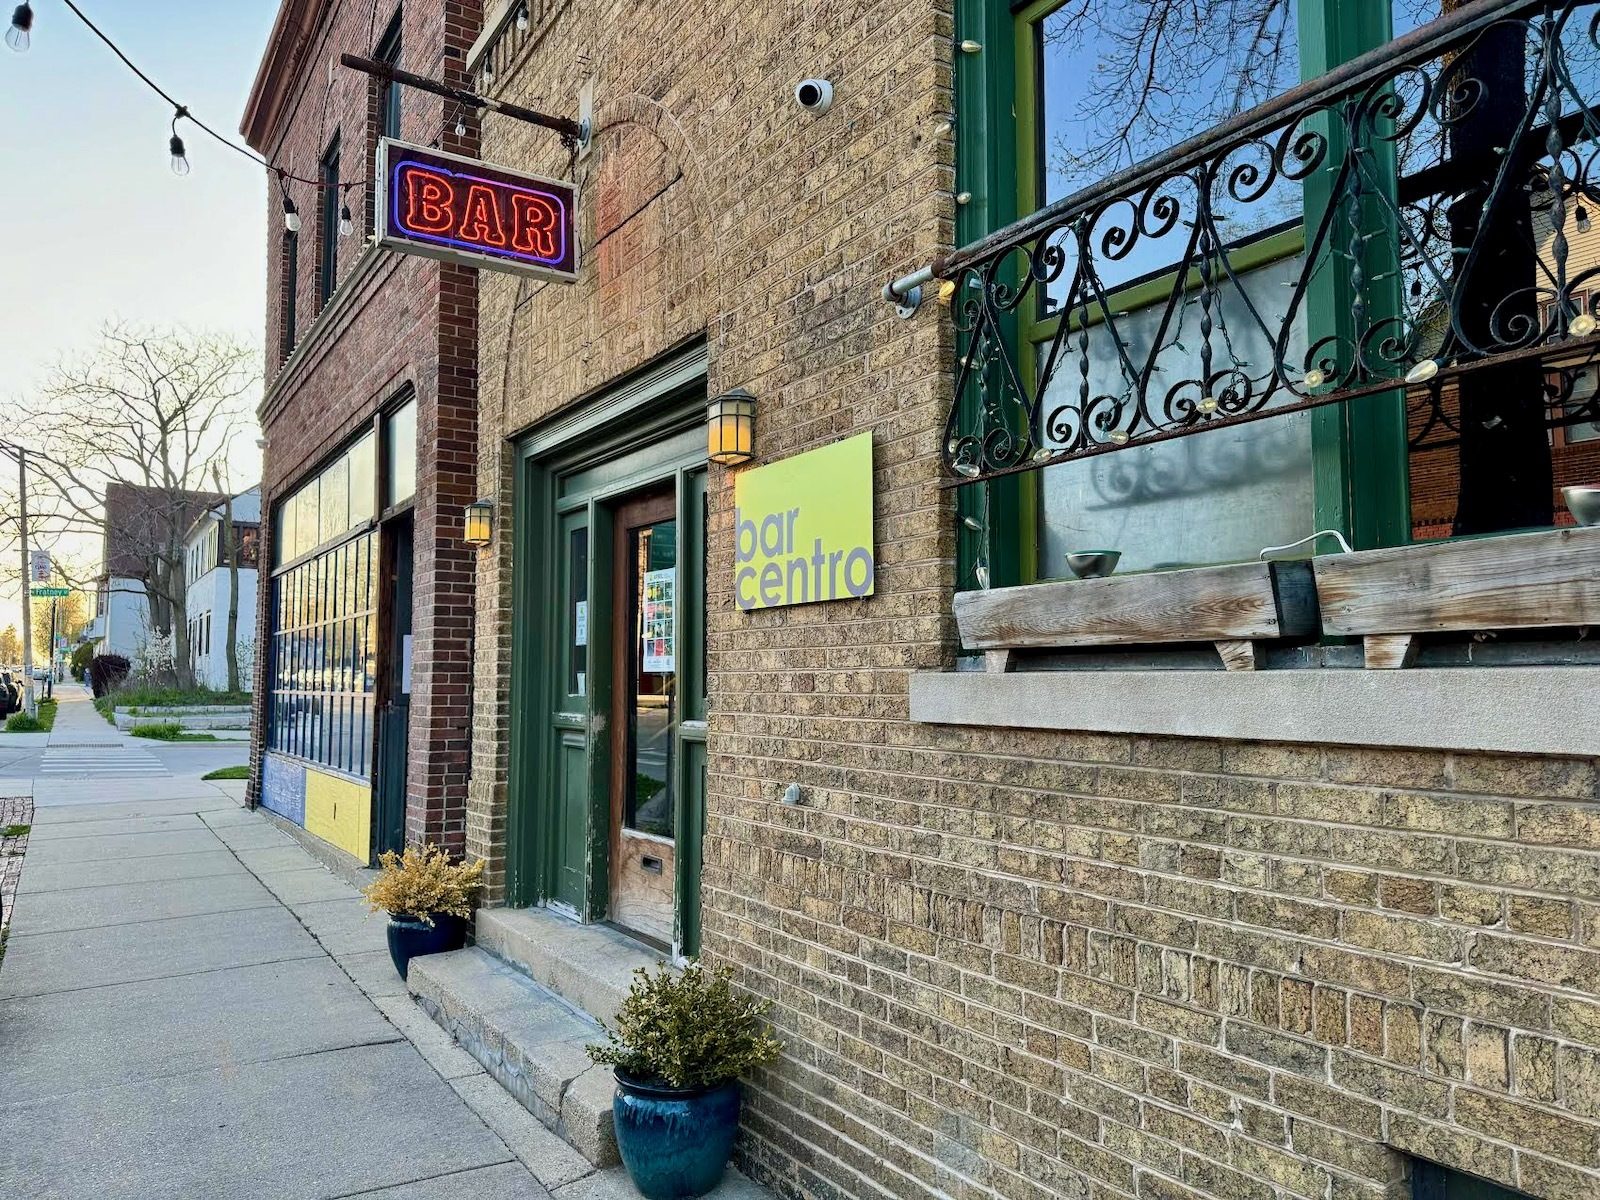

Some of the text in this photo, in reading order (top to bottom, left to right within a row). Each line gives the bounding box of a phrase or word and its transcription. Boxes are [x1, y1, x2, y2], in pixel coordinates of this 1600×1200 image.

[406, 169, 555, 256] BAR
[735, 507, 800, 563] bar
[736, 538, 873, 611] centro
